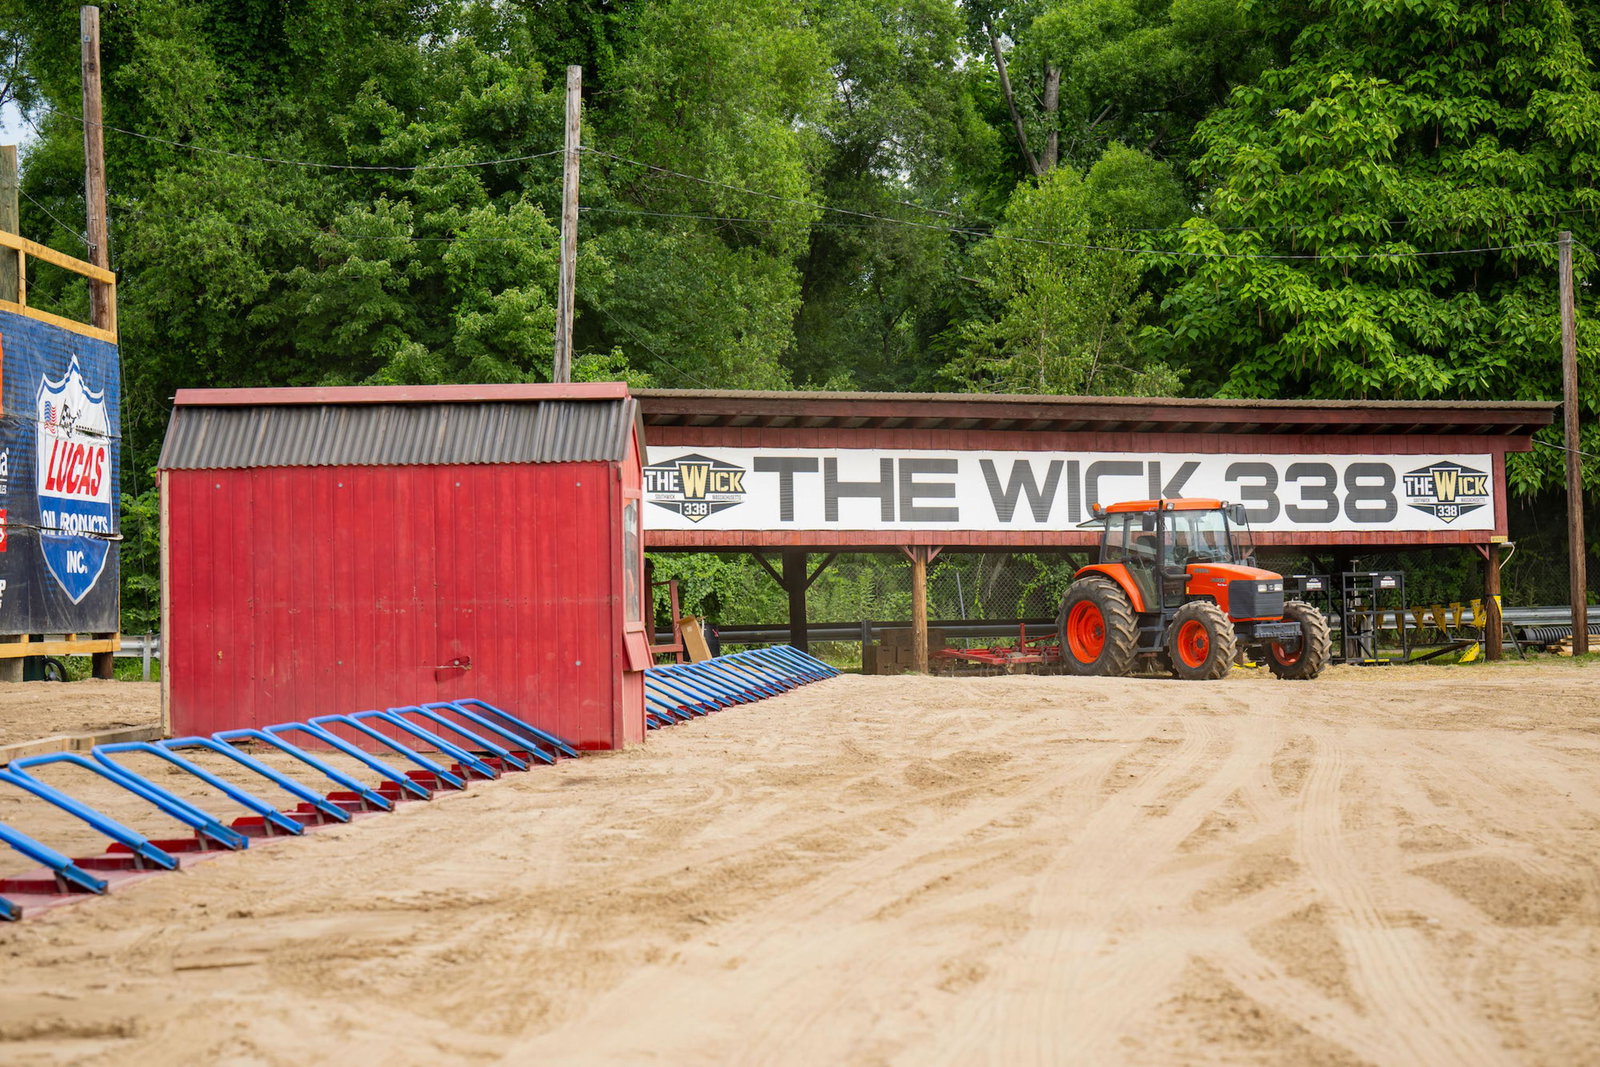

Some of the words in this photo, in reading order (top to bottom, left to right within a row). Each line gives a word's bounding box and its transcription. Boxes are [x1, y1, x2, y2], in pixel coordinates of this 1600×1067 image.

[45, 440, 105, 496] LUCAS
[644, 471, 680, 491] THE
[680, 465, 744, 498] WICK
[753, 456, 960, 522] THE
[979, 459, 1201, 523] WICK
[1225, 461, 1398, 523] 338
[1404, 476, 1434, 496] THE
[1433, 471, 1487, 501] WICK
[684, 502, 708, 515] 338
[1437, 505, 1458, 517] 338
[41, 509, 56, 536] OIL
[58, 511, 109, 540] PRODUCTS
[66, 550, 88, 574] INC.
